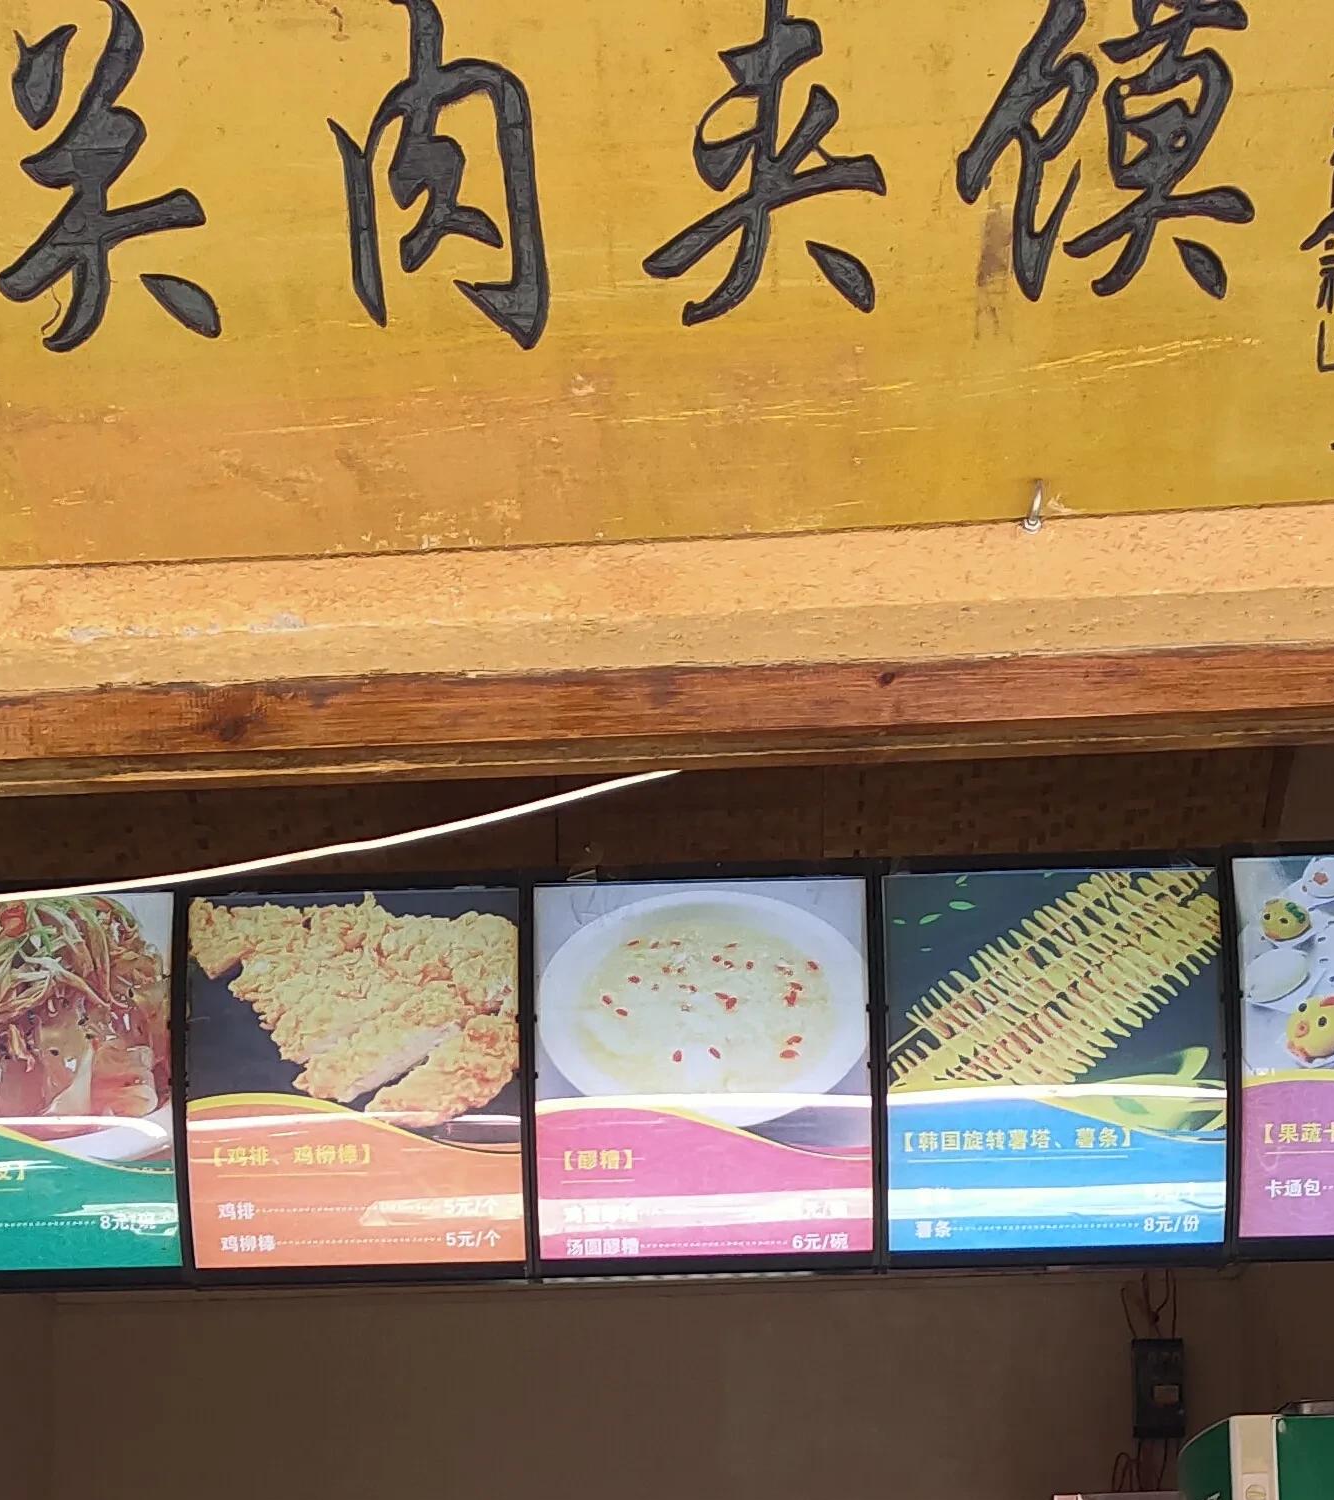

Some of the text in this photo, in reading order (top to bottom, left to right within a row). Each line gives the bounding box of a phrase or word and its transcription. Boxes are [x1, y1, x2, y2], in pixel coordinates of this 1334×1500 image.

[1265, 1178, 1322, 1198] 卡通包
[218, 1202, 256, 1220] 鸡排
[915, 1215, 1200, 1239] 薯条 8元/份
[221, 1230, 501, 1253] 鸡柳棒 5元/个
[791, 1232, 849, 1250] 6元/碗
